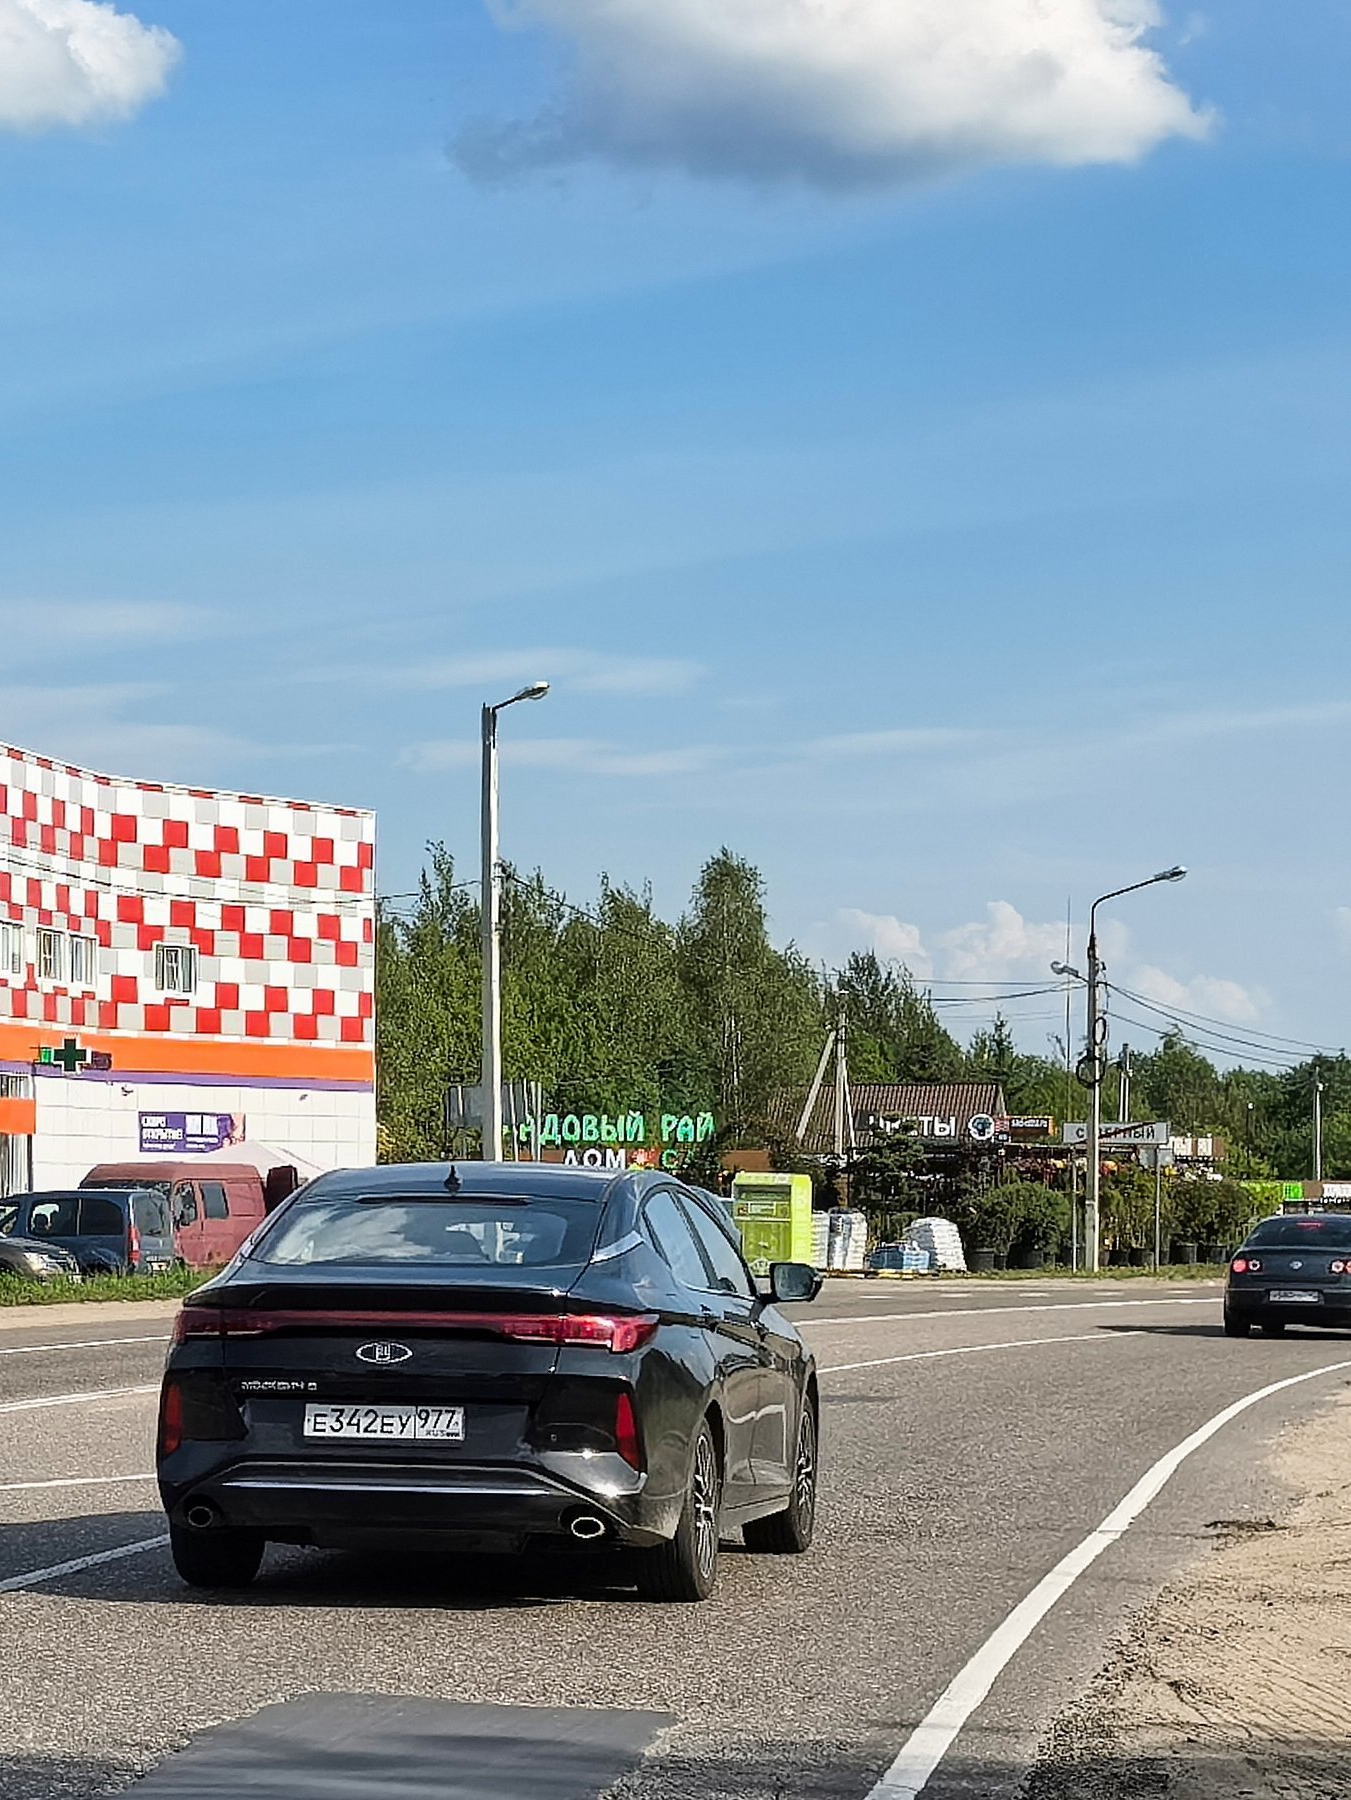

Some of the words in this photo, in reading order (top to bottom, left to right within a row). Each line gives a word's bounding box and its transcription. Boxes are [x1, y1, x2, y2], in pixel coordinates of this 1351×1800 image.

[661, 1112, 715, 1142] РАЙ
[1075, 1124, 1155, 1140] СЕРНЫЙ
[313, 1408, 412, 1434] Е342ЕУ
[417, 1409, 457, 1429] 977
